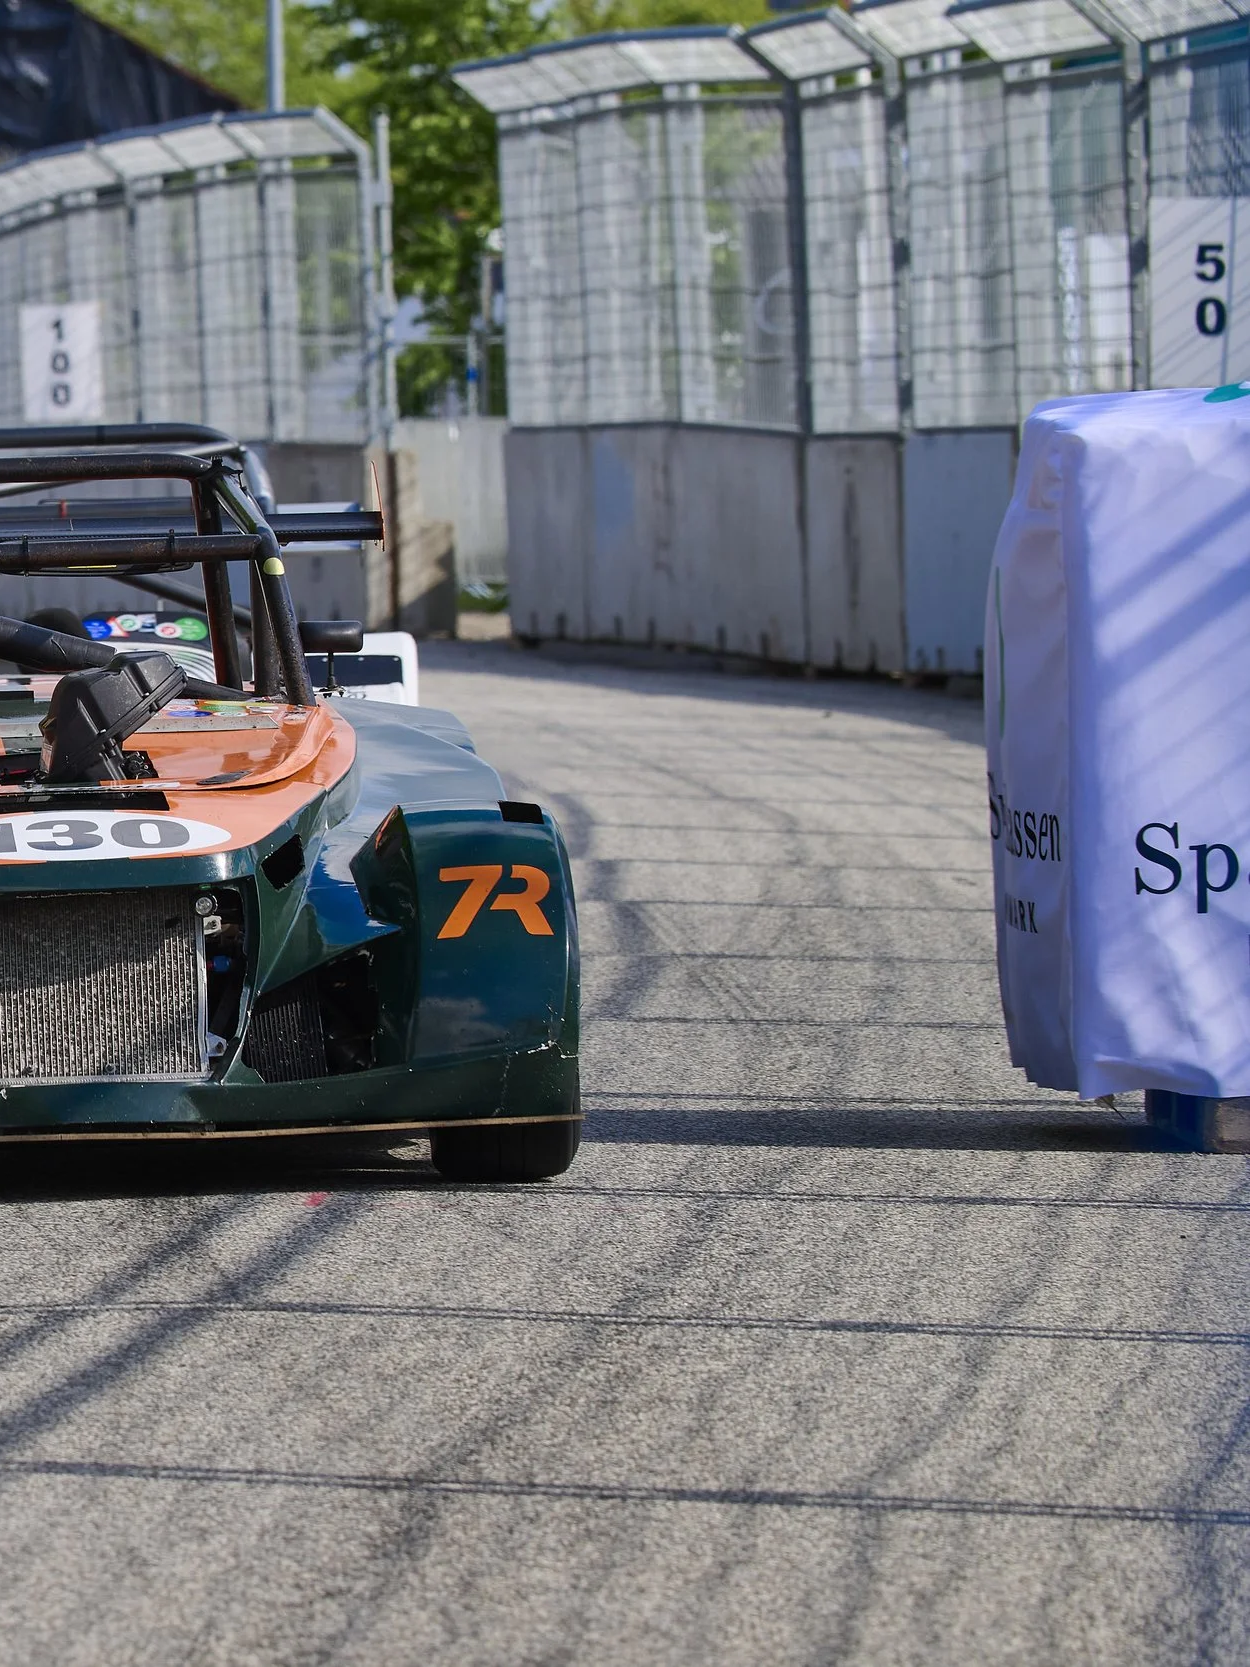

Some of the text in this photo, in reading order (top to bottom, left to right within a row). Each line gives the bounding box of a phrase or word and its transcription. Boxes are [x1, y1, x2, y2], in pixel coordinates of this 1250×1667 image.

[1194, 243, 1227, 337] 50
[51, 319, 71, 408] 100
[437, 864, 555, 940] 7R
[1134, 821, 1250, 915] Sp
